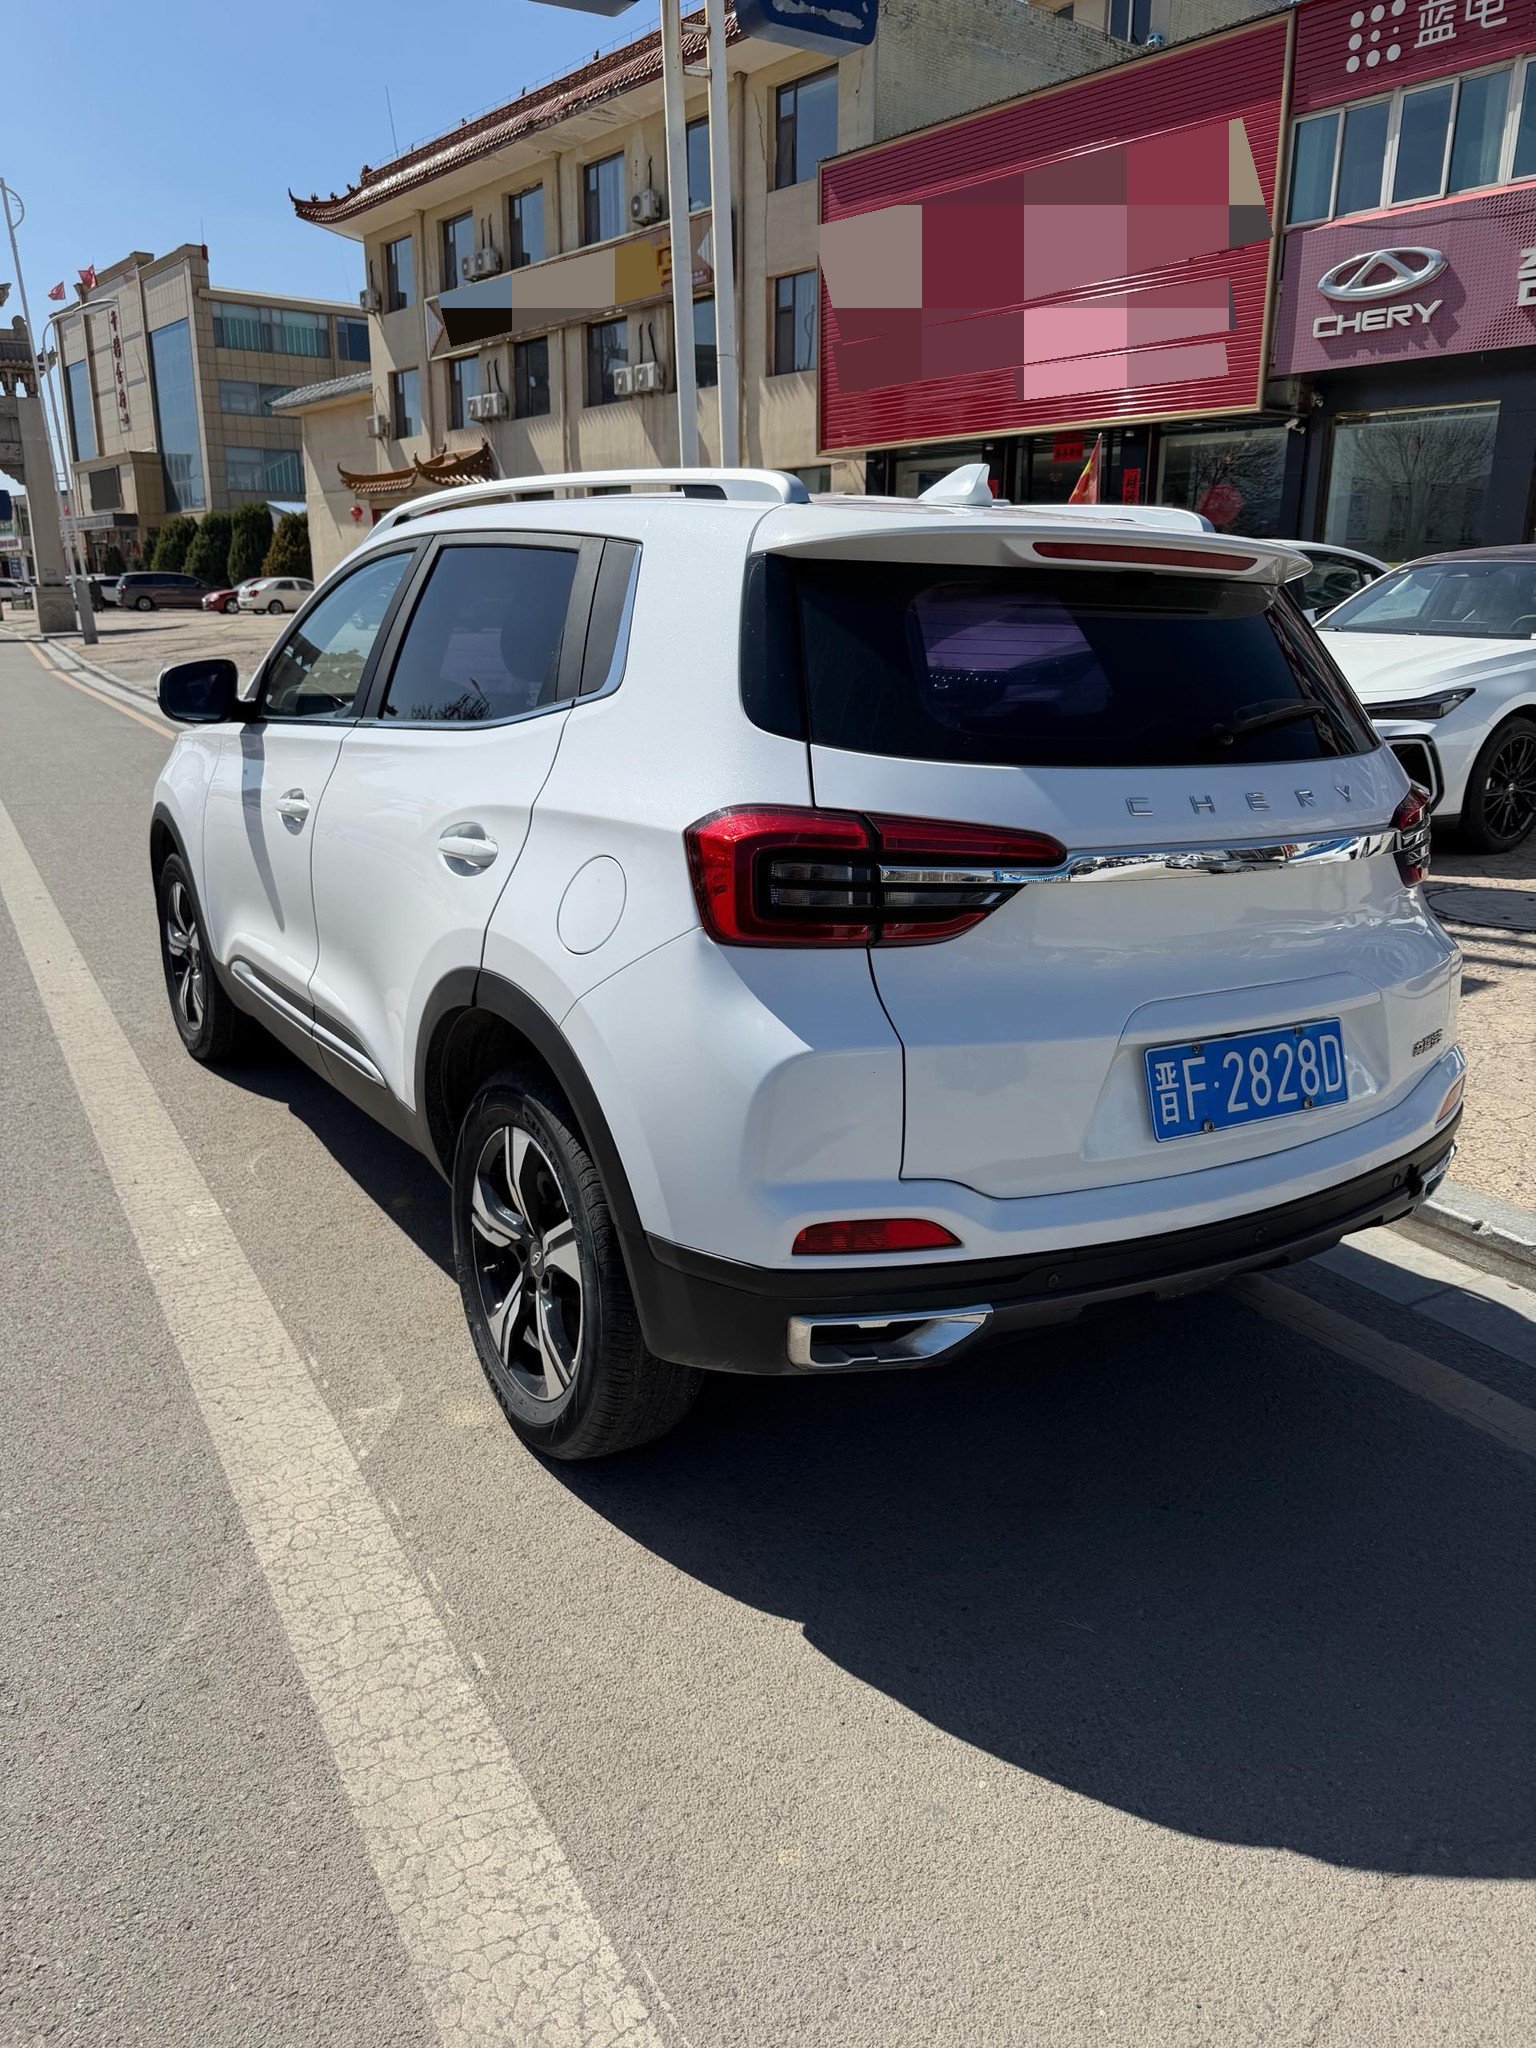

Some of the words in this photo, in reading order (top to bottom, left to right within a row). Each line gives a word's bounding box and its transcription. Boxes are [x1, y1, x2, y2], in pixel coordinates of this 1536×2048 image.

[1413, 0, 1508, 49] 蓝电
[1313, 299, 1444, 339] CHERY
[1126, 785, 1351, 816] CHERY
[1154, 1034, 1343, 1126] 晋F·2828D
